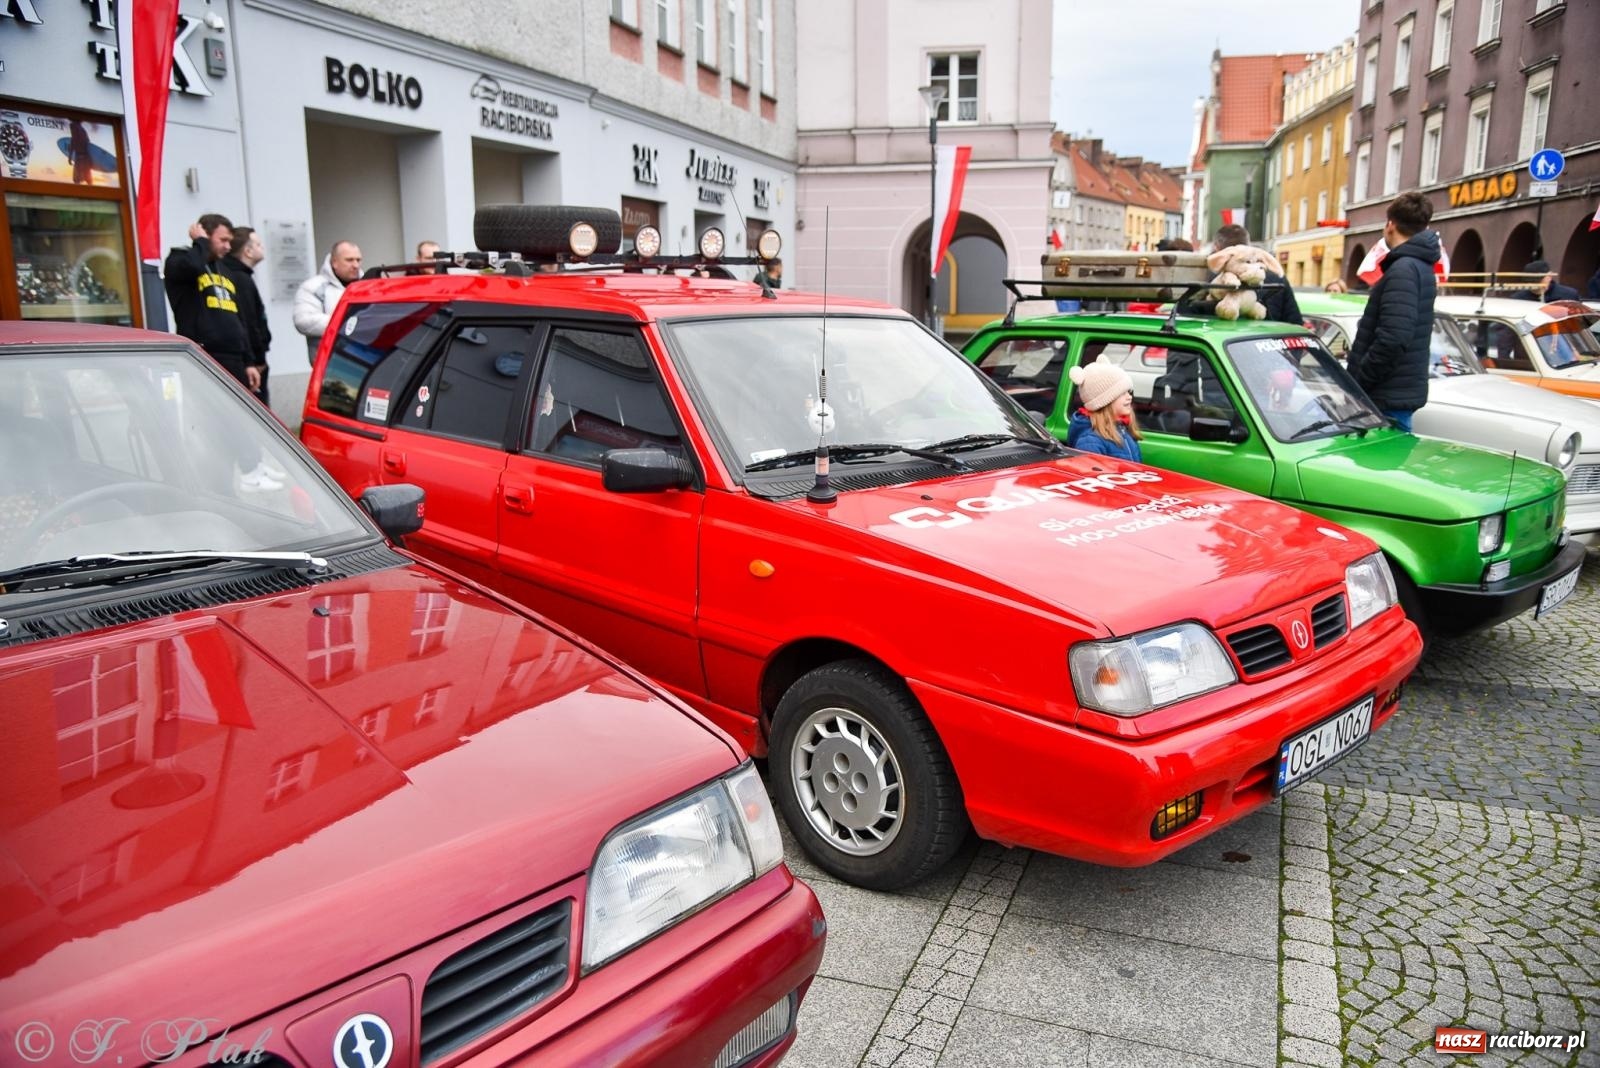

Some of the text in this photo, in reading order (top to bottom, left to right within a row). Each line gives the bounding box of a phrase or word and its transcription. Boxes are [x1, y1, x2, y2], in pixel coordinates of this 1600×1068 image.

[325, 55, 423, 110] BOLKO
[26, 116, 65, 131] ORIENT
[480, 106, 553, 141] RACIBORSKA
[956, 471, 1163, 513] QUATROS
[1056, 528, 1118, 547] Moc
[1290, 729, 1326, 776] OGL
